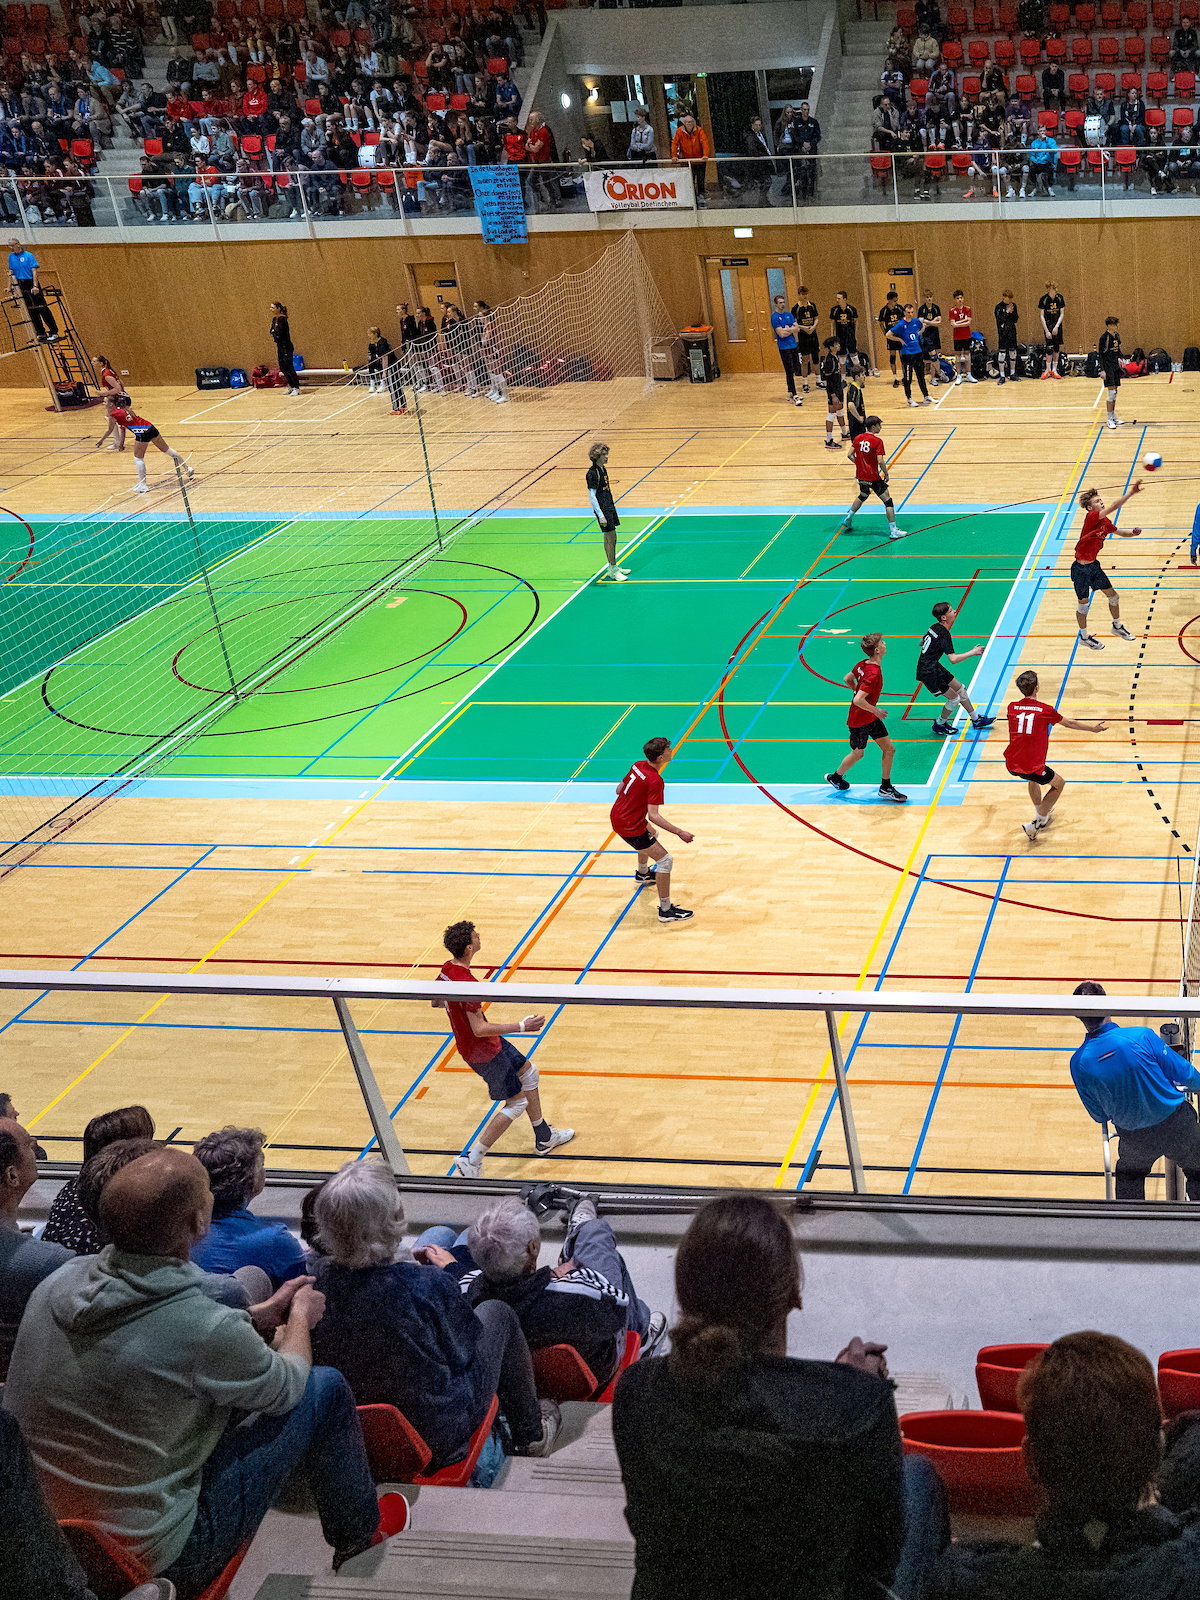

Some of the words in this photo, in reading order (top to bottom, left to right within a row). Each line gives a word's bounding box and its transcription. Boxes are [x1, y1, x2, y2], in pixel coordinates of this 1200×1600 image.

[606, 175, 677, 201] ORION
[859, 440, 871, 453] 18
[1016, 712, 1036, 735] 11
[623, 773, 637, 795] 7
